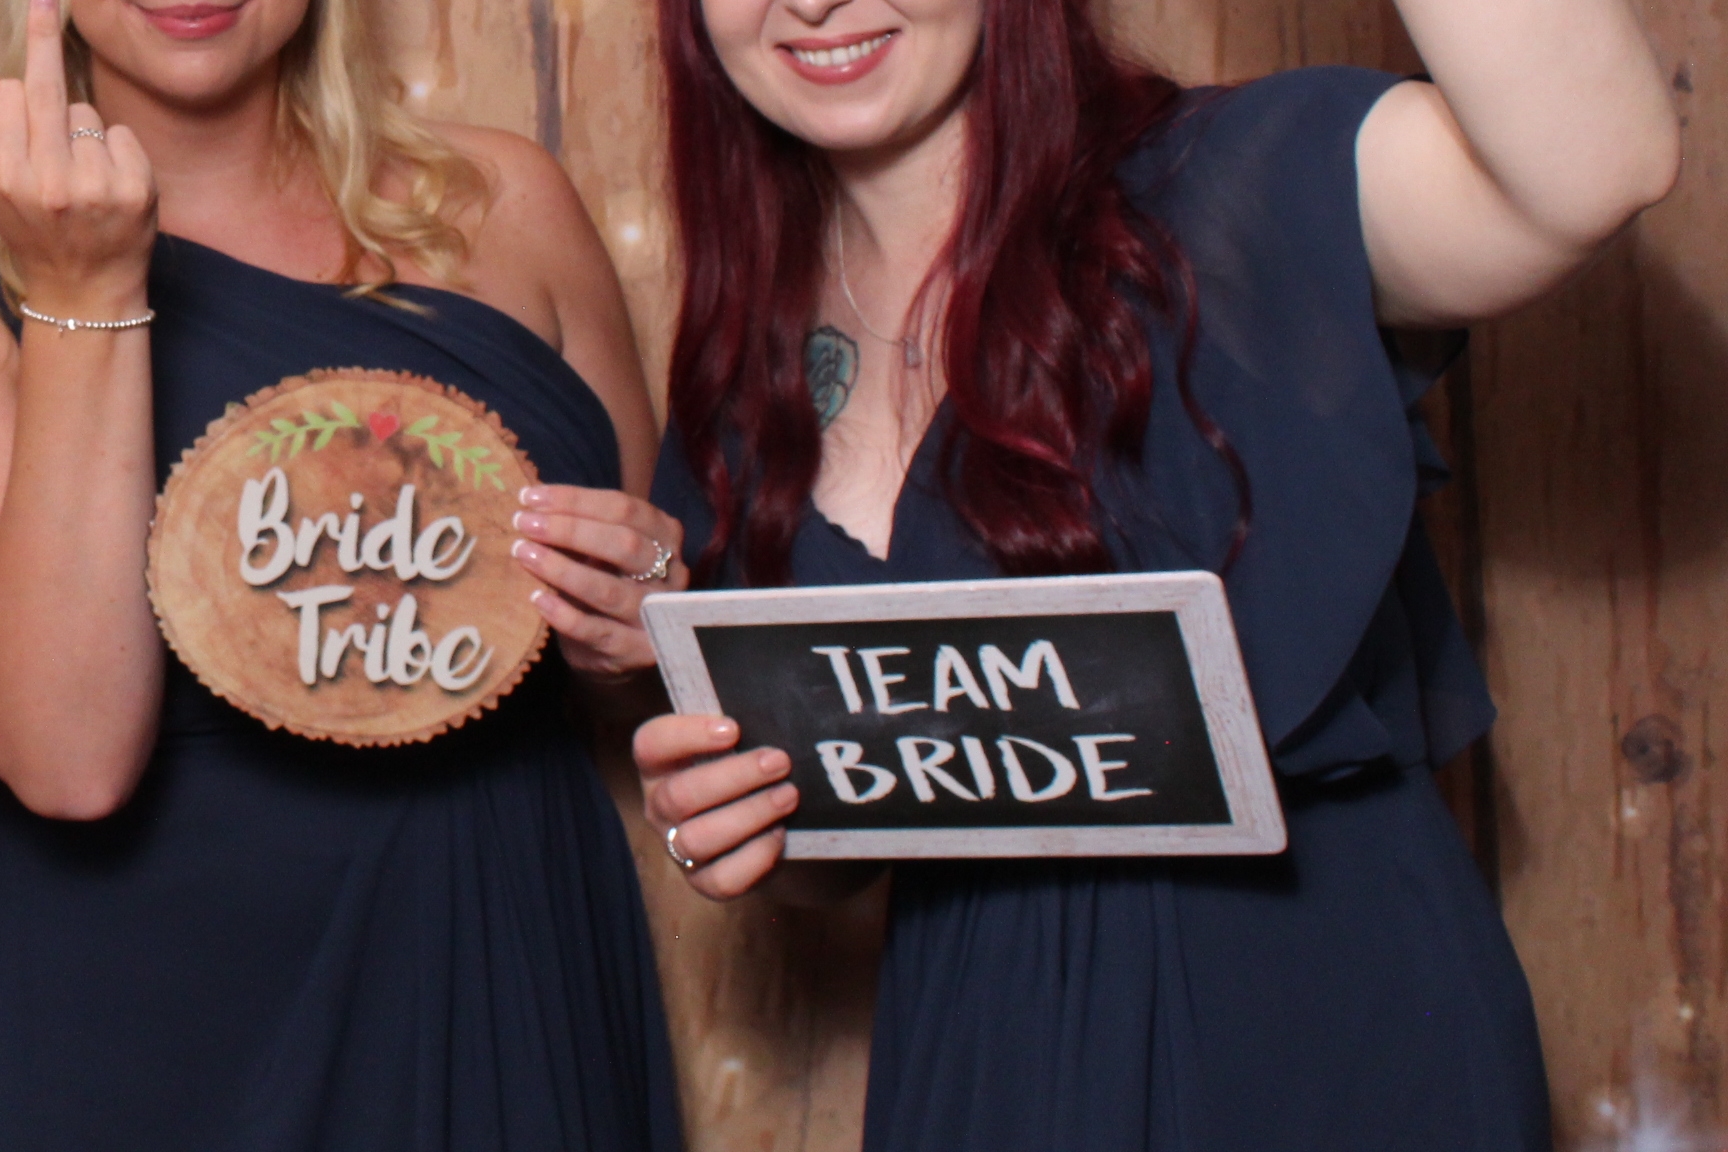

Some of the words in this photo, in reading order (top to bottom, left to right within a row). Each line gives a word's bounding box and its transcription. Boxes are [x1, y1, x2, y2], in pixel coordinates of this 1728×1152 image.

[237, 466, 477, 586] Bride
[276, 584, 495, 691] Tribe
[810, 639, 1080, 715] TEAM
[815, 733, 1154, 804] BRIDE
